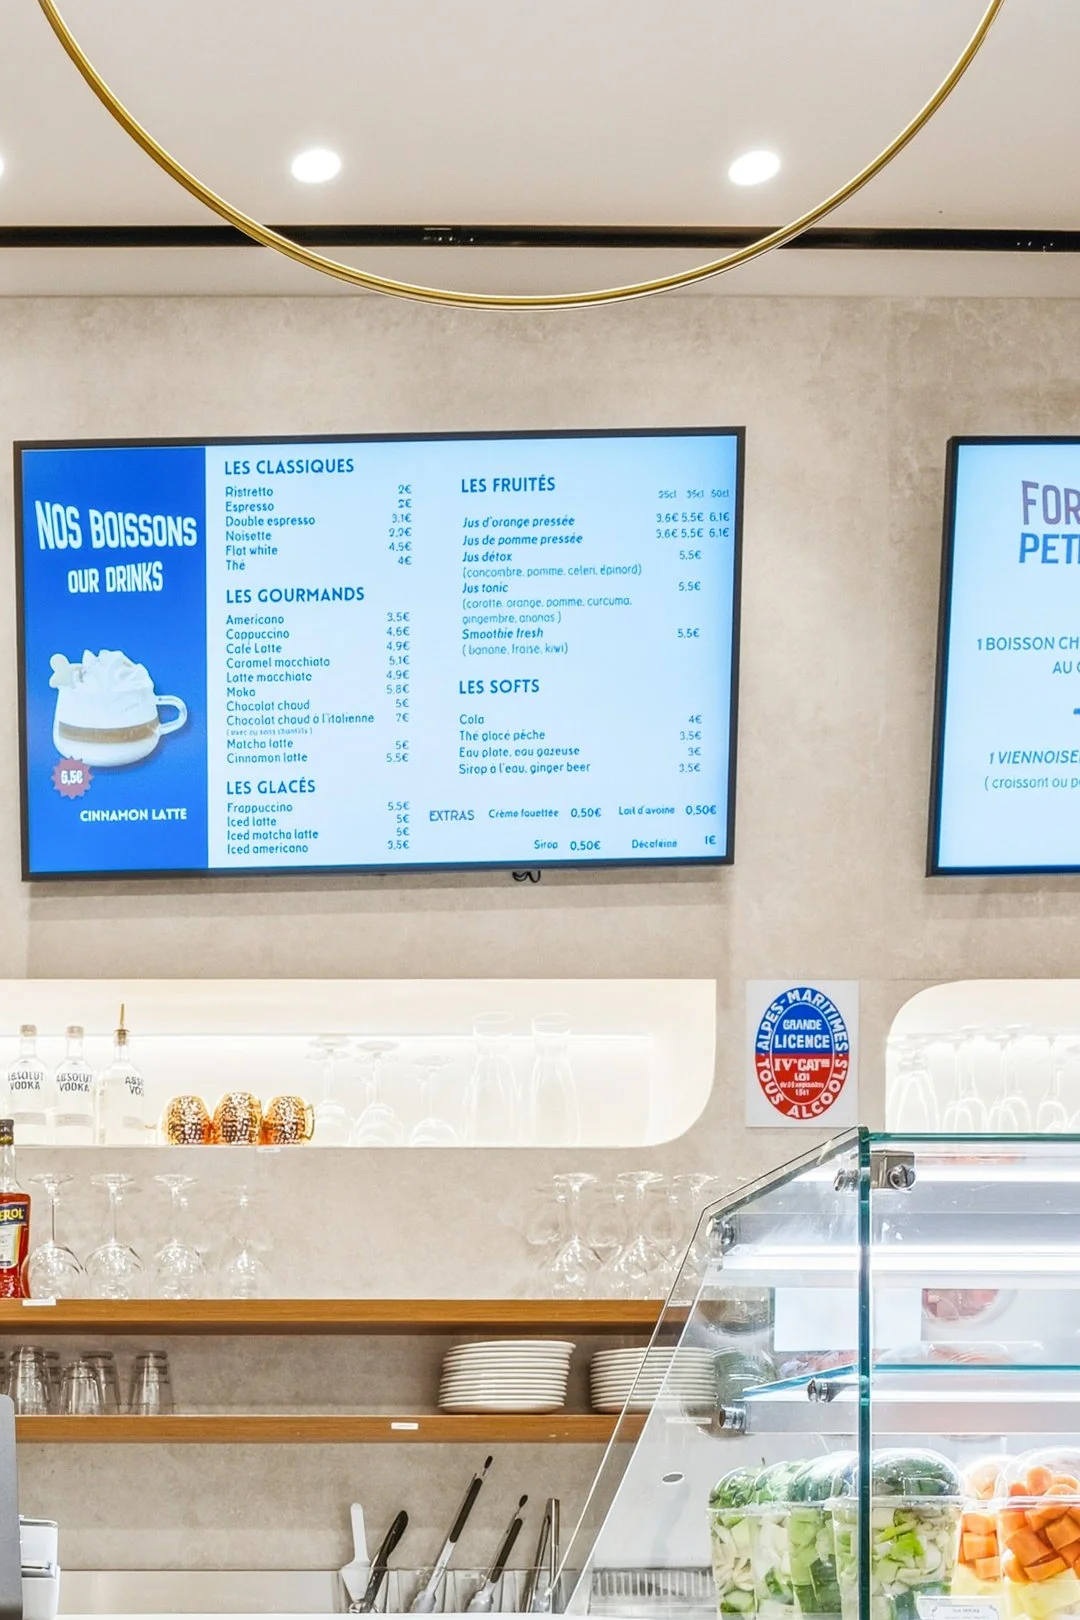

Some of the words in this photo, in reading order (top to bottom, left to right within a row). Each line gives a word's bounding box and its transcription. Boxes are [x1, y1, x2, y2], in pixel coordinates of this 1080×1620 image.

[225, 460, 251, 475] LES
[256, 458, 354, 475] CLASSIQUES
[461, 478, 487, 493] LES
[492, 474, 556, 493] FRUITÉS
[225, 486, 274, 497] Ristretto
[225, 501, 275, 513] Espresso
[34, 500, 82, 550] NOS
[88, 508, 198, 550] BOISSONS
[225, 516, 264, 527] Double
[267, 516, 316, 528] espresso
[462, 517, 480, 529] Jus
[225, 530, 272, 542] Noisette
[462, 535, 480, 547] Jus
[482, 535, 496, 546] de
[497, 535, 538, 547] pomme
[249, 544, 278, 555] white
[1019, 532, 1080, 564] PET
[462, 551, 480, 563] Jus
[225, 559, 246, 571] Thé
[68, 567, 100, 593] OUR
[105, 561, 164, 593] DRINKS
[462, 582, 480, 595] Jus
[482, 581, 509, 594] tonic
[226, 589, 252, 604] LES
[257, 587, 365, 603] GOURMANDS
[225, 614, 284, 625] Americano
[226, 628, 290, 641] Cappuccino
[462, 626, 514, 640] Smoothie
[516, 626, 544, 639] fresh
[254, 643, 282, 654] Latte
[985, 637, 1055, 651] BOISSON
[226, 657, 272, 669] Caramel
[274, 656, 330, 668] macchiato
[1052, 660, 1073, 675] AU
[226, 672, 254, 683] Latte
[256, 671, 313, 683] macchiato
[459, 680, 485, 695] LES
[490, 678, 540, 694] SOFTS
[226, 700, 275, 712] Chocolat
[277, 700, 310, 711] chaud
[226, 714, 275, 726] Chocolat
[278, 714, 311, 725] chaud
[459, 713, 485, 726] Cola
[227, 738, 266, 750] Matcha
[269, 738, 294, 749] latte
[227, 752, 281, 764] Cinnamon
[283, 751, 308, 762] latte
[459, 746, 479, 758] Eau
[514, 746, 534, 757] eau
[998, 750, 1080, 765] VIENNOISE
[459, 763, 488, 776] Sirop
[530, 762, 564, 775] ginger
[566, 762, 591, 773] beer
[226, 781, 252, 795] LES
[257, 776, 316, 794] GLACÉS
[992, 776, 1049, 789] croissant
[1052, 777, 1068, 788] ou
[79, 808, 148, 821] CINNAMON
[152, 807, 188, 821] LATTE
[227, 801, 293, 814] Frappuccino
[227, 816, 250, 827] Iced
[252, 815, 277, 826] latte
[429, 810, 475, 822] EXTRAS
[488, 808, 519, 819] Crème
[227, 830, 250, 841] Iced
[252, 829, 292, 840] matcha
[294, 828, 319, 839] latte
[227, 844, 251, 854] Iced
[253, 842, 309, 853] americano
[534, 839, 558, 851] Sirop
[757, 989, 848, 1052] ALPES-MARITIMES
[783, 1019, 822, 1030] GRANDE
[775, 1034, 830, 1048] LICENCE
[56, 1073, 92, 1083] ABSOLUT
[10, 1081, 41, 1090] VODKA
[59, 1082, 90, 1092] VODKA
[757, 1058, 784, 1105] TOUS
[787, 1059, 848, 1118] ALCOOLS
